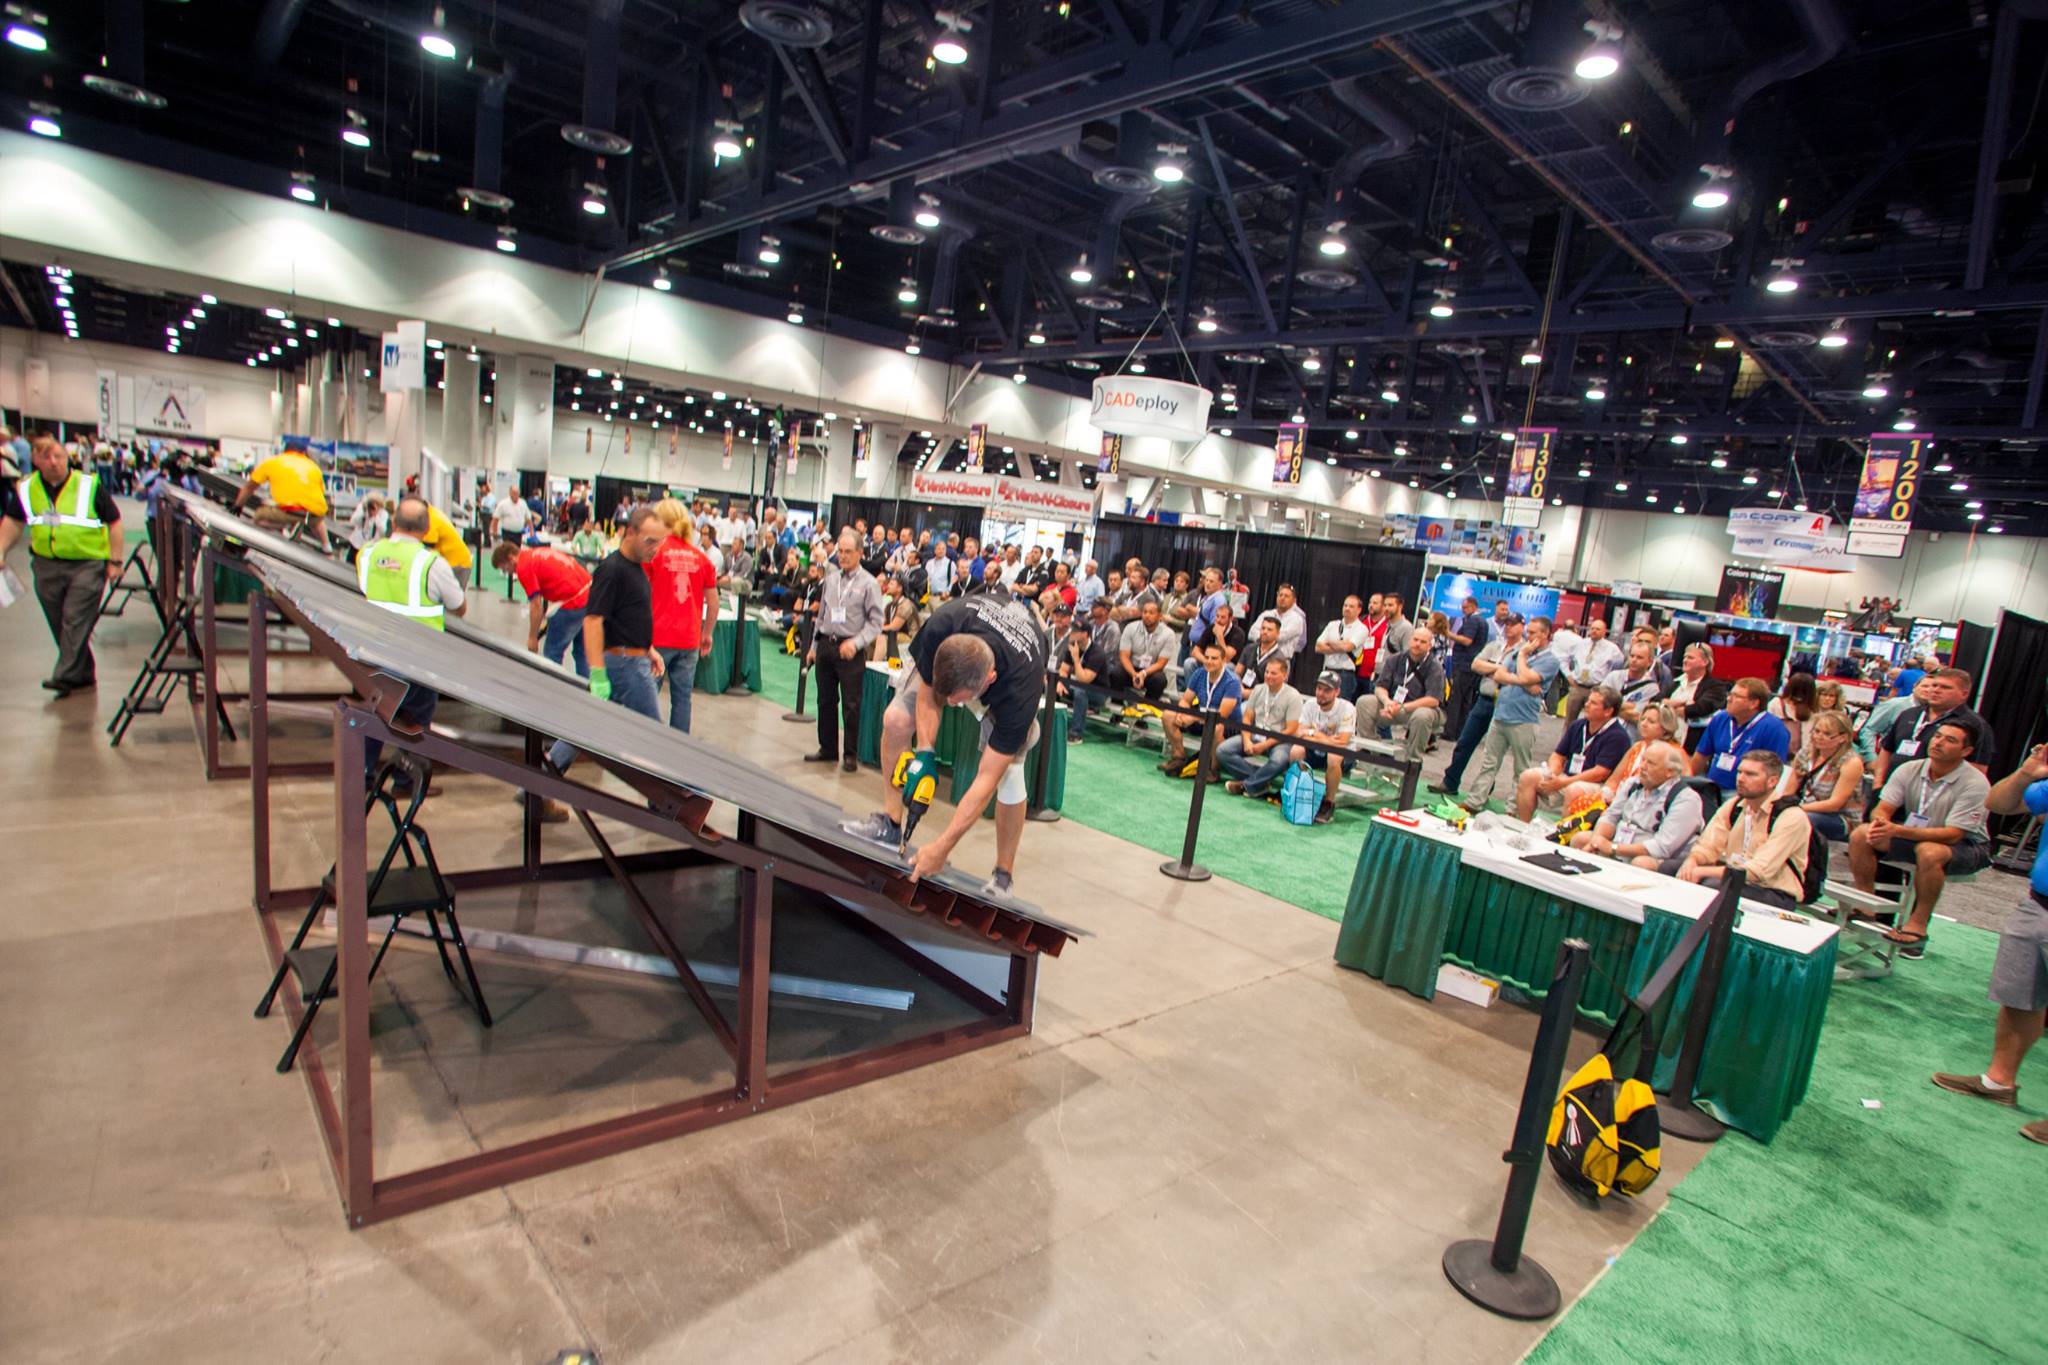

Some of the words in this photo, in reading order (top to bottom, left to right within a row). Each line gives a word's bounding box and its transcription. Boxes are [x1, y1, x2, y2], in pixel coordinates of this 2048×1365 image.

[1103, 391, 1179, 415] CADeploy
[1290, 428, 1304, 483] 1400
[1530, 432, 1550, 498] 1300
[1890, 440, 1921, 521] 1200
[1727, 568, 1749, 578] Colors
